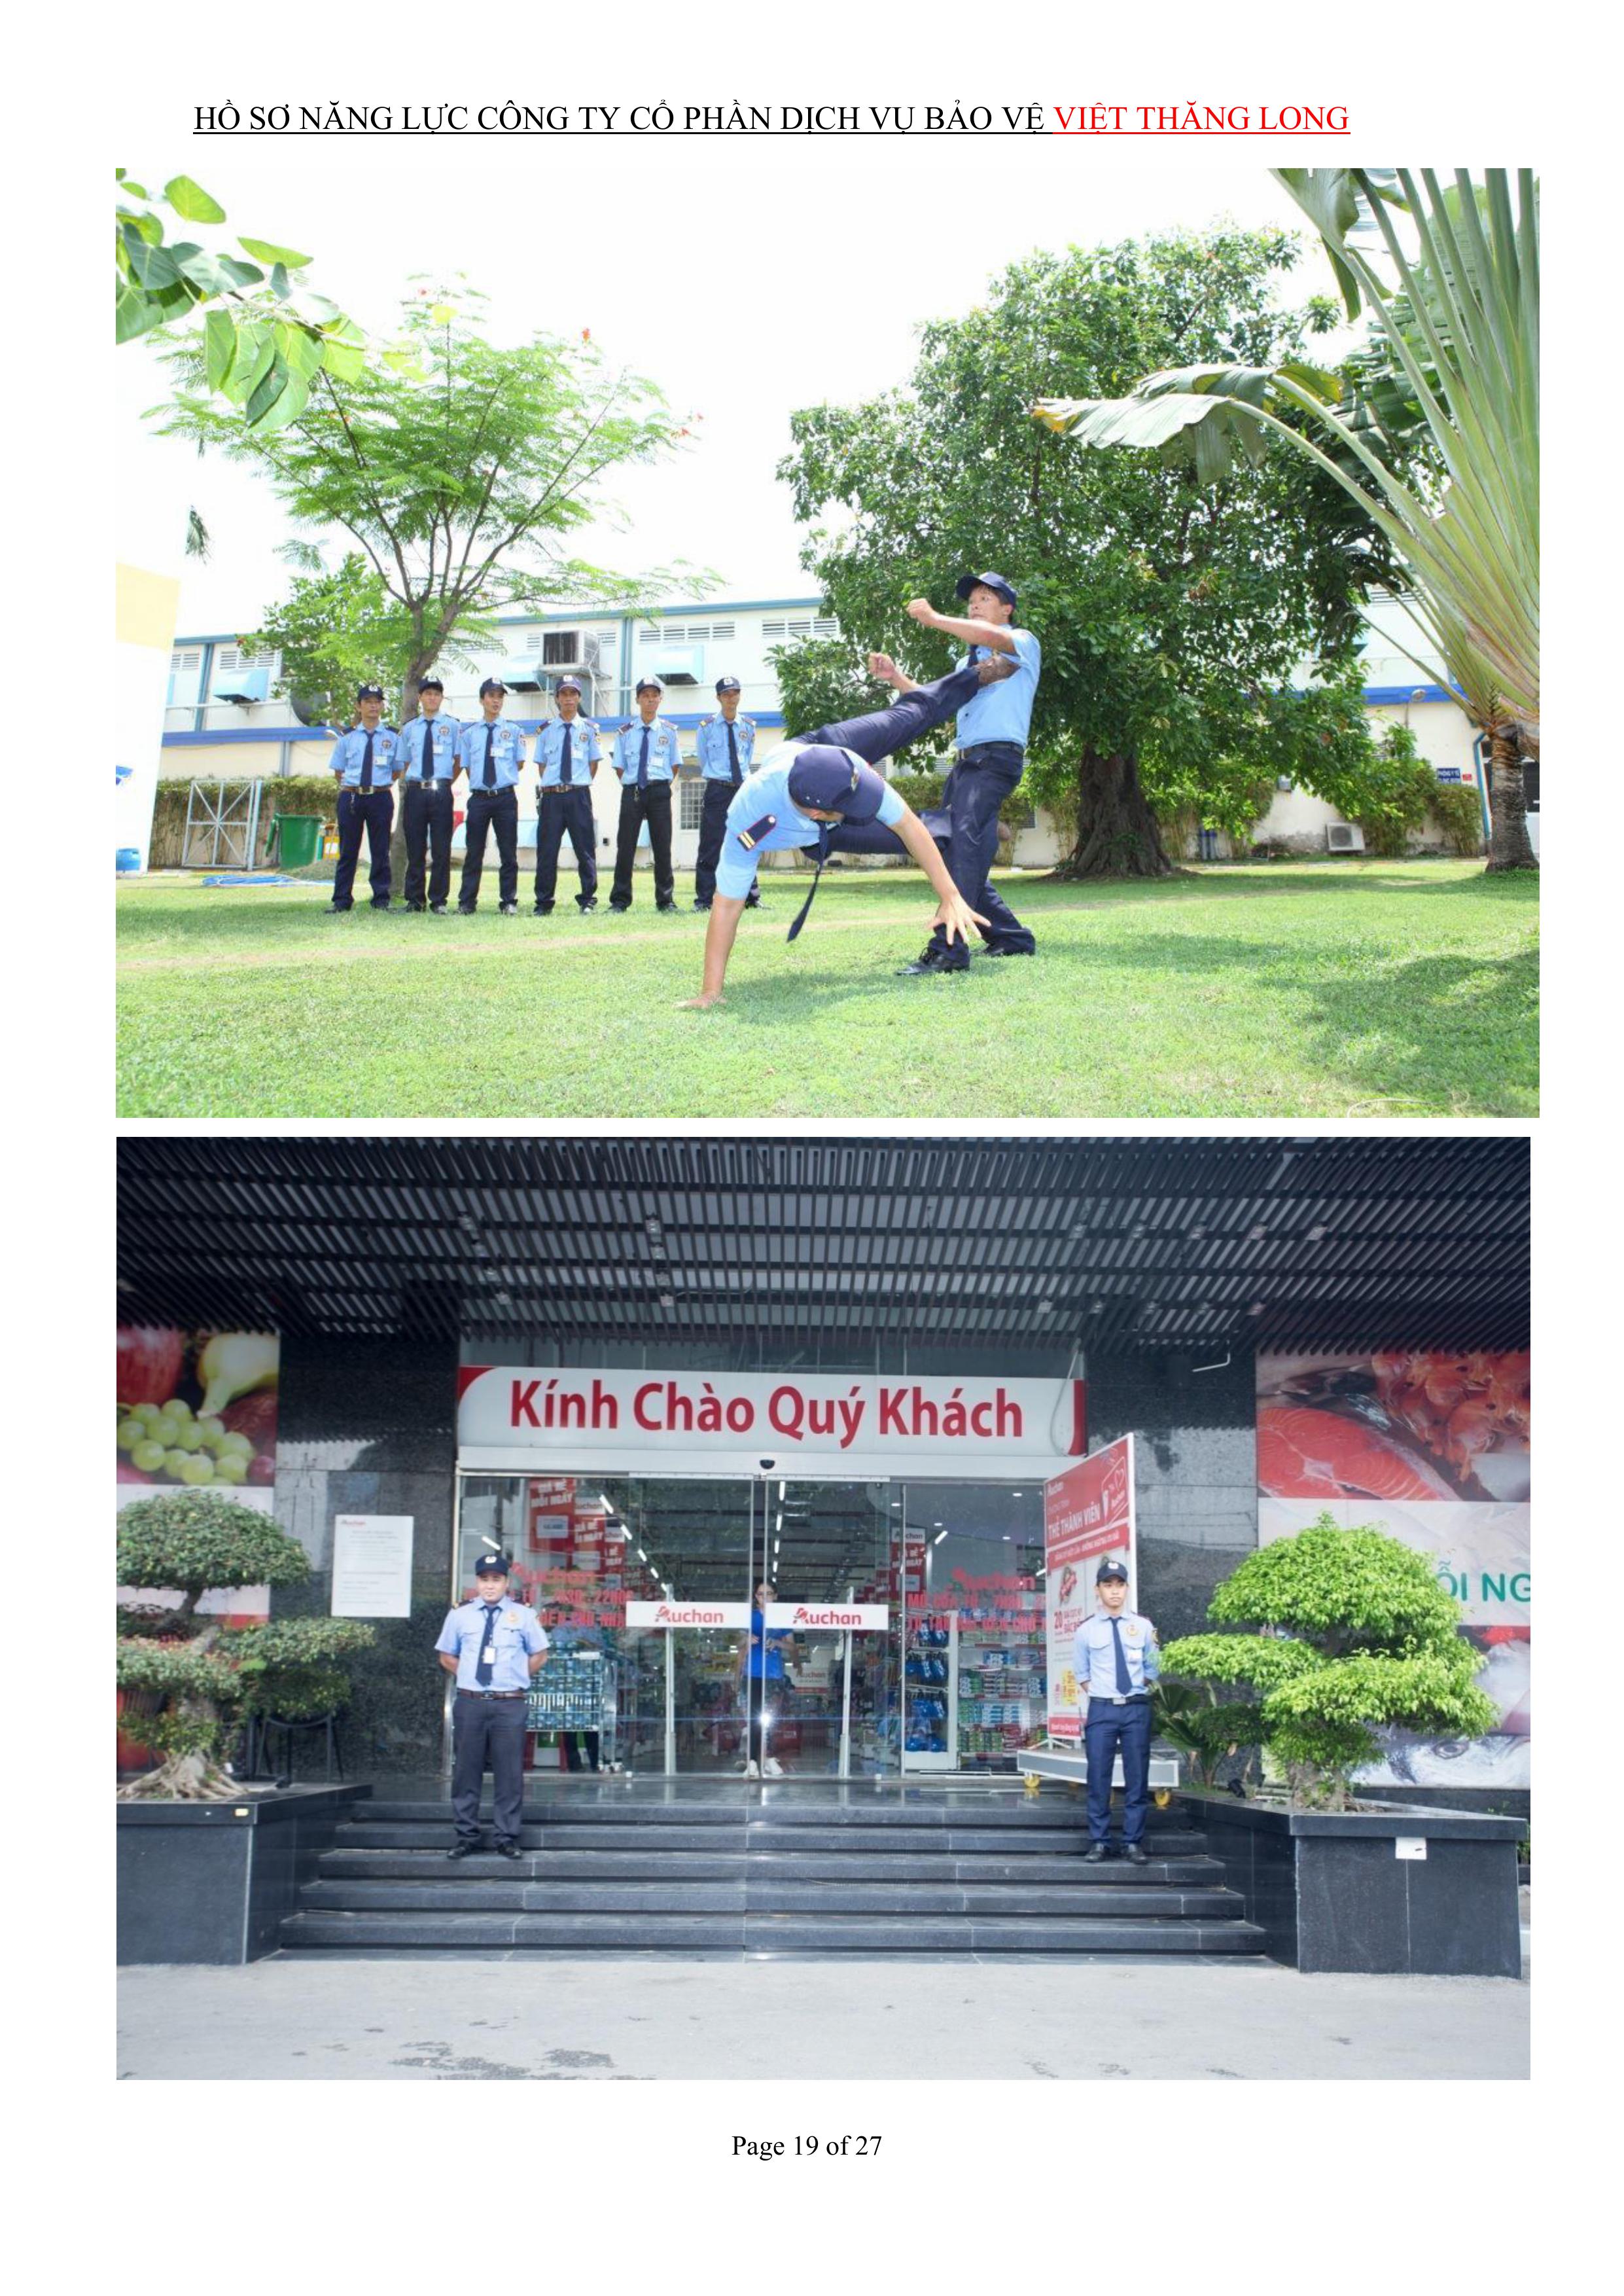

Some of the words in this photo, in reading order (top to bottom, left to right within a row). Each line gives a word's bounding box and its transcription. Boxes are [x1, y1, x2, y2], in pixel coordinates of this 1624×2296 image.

[194, 99, 240, 130] HỒ
[250, 103, 290, 130] SƠ
[298, 100, 393, 130] NĂNG
[401, 103, 468, 134] LỰC
[478, 99, 569, 130] CÔNG
[578, 107, 621, 130] TY
[630, 99, 674, 130] CỔ
[683, 99, 772, 130] PHẦN
[780, 106, 860, 134] DỊCH
[868, 107, 915, 134] VỤ
[924, 99, 992, 130] BẢO
[1000, 102, 1044, 134] VỆ
[1053, 102, 1127, 134] VIỆT
[1137, 100, 1250, 130] THĂNG
[1258, 106, 1349, 130] LONG
[511, 1379, 618, 1429] Kính
[633, 1381, 755, 1433] Chào
[768, 1385, 865, 1448] Quý
[879, 1387, 1023, 1437] Khách
[894, 1530, 923, 1541] Achan
[655, 1605, 724, 1623] Auchan
[793, 1607, 862, 1625] Auchan
[732, 2136, 785, 2161] Page
[795, 2136, 819, 2156] 19
[826, 2135, 851, 2156] of
[855, 2136, 882, 2156] 27
